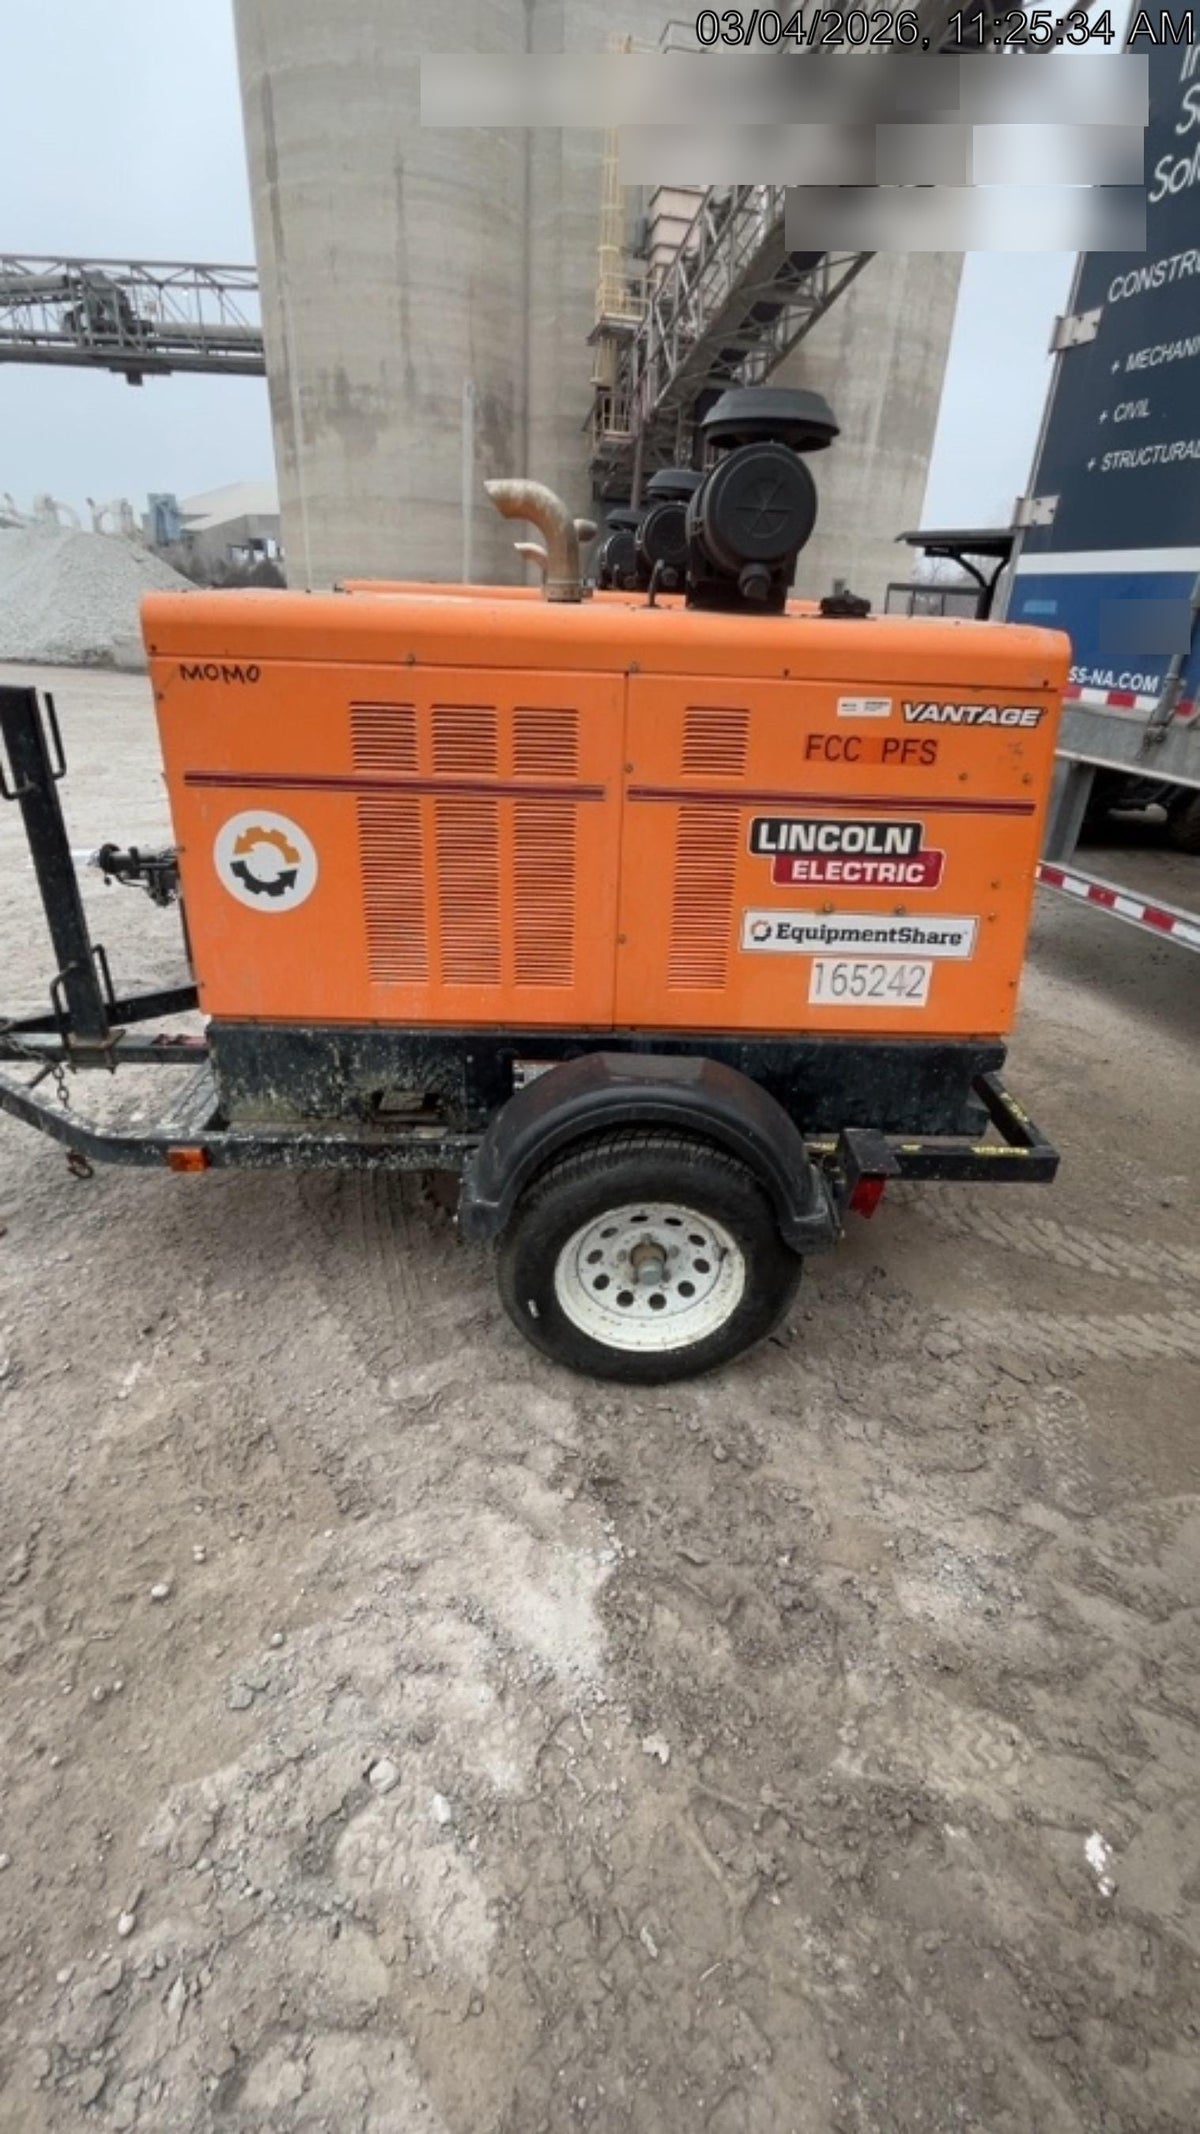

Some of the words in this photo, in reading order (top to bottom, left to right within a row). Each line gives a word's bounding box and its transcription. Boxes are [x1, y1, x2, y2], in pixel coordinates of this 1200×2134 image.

[179, 663, 260, 684] MOMO
[902, 702, 1042, 727] VANTAGE
[805, 734, 863, 761] FCC
[881, 737, 938, 765] PFS
[758, 822, 914, 855] LINCOLN
[790, 859, 926, 884] ELECTRIC
[775, 922, 962, 946] EquipmentShare
[813, 962, 927, 998] 165242
